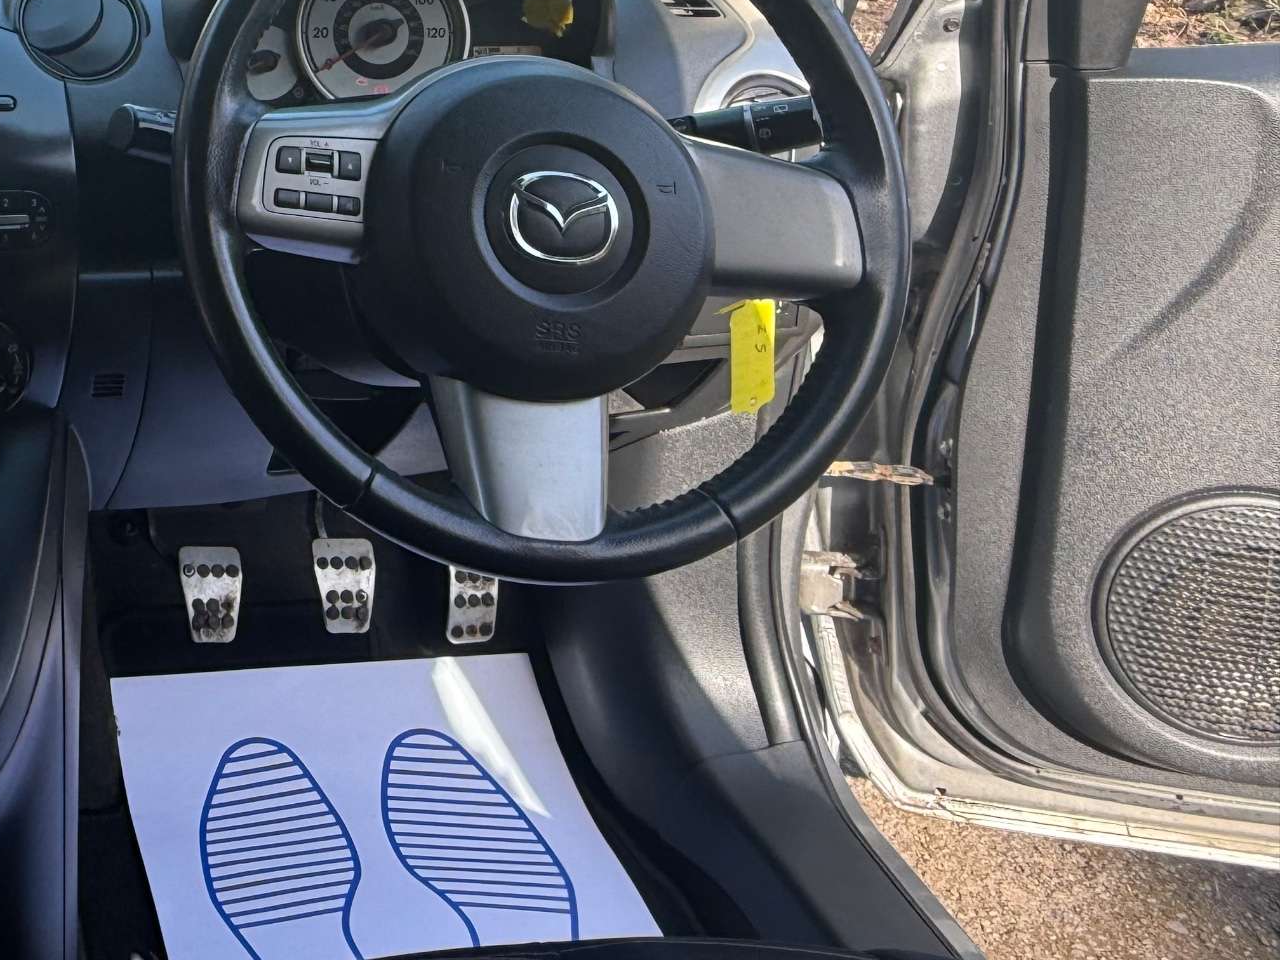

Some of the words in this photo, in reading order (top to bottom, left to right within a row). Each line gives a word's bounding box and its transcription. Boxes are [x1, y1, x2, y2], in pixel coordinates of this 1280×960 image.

[313, 26, 329, 39] 20
[425, 27, 446, 40] 120
[309, 178, 321, 187] VOL
